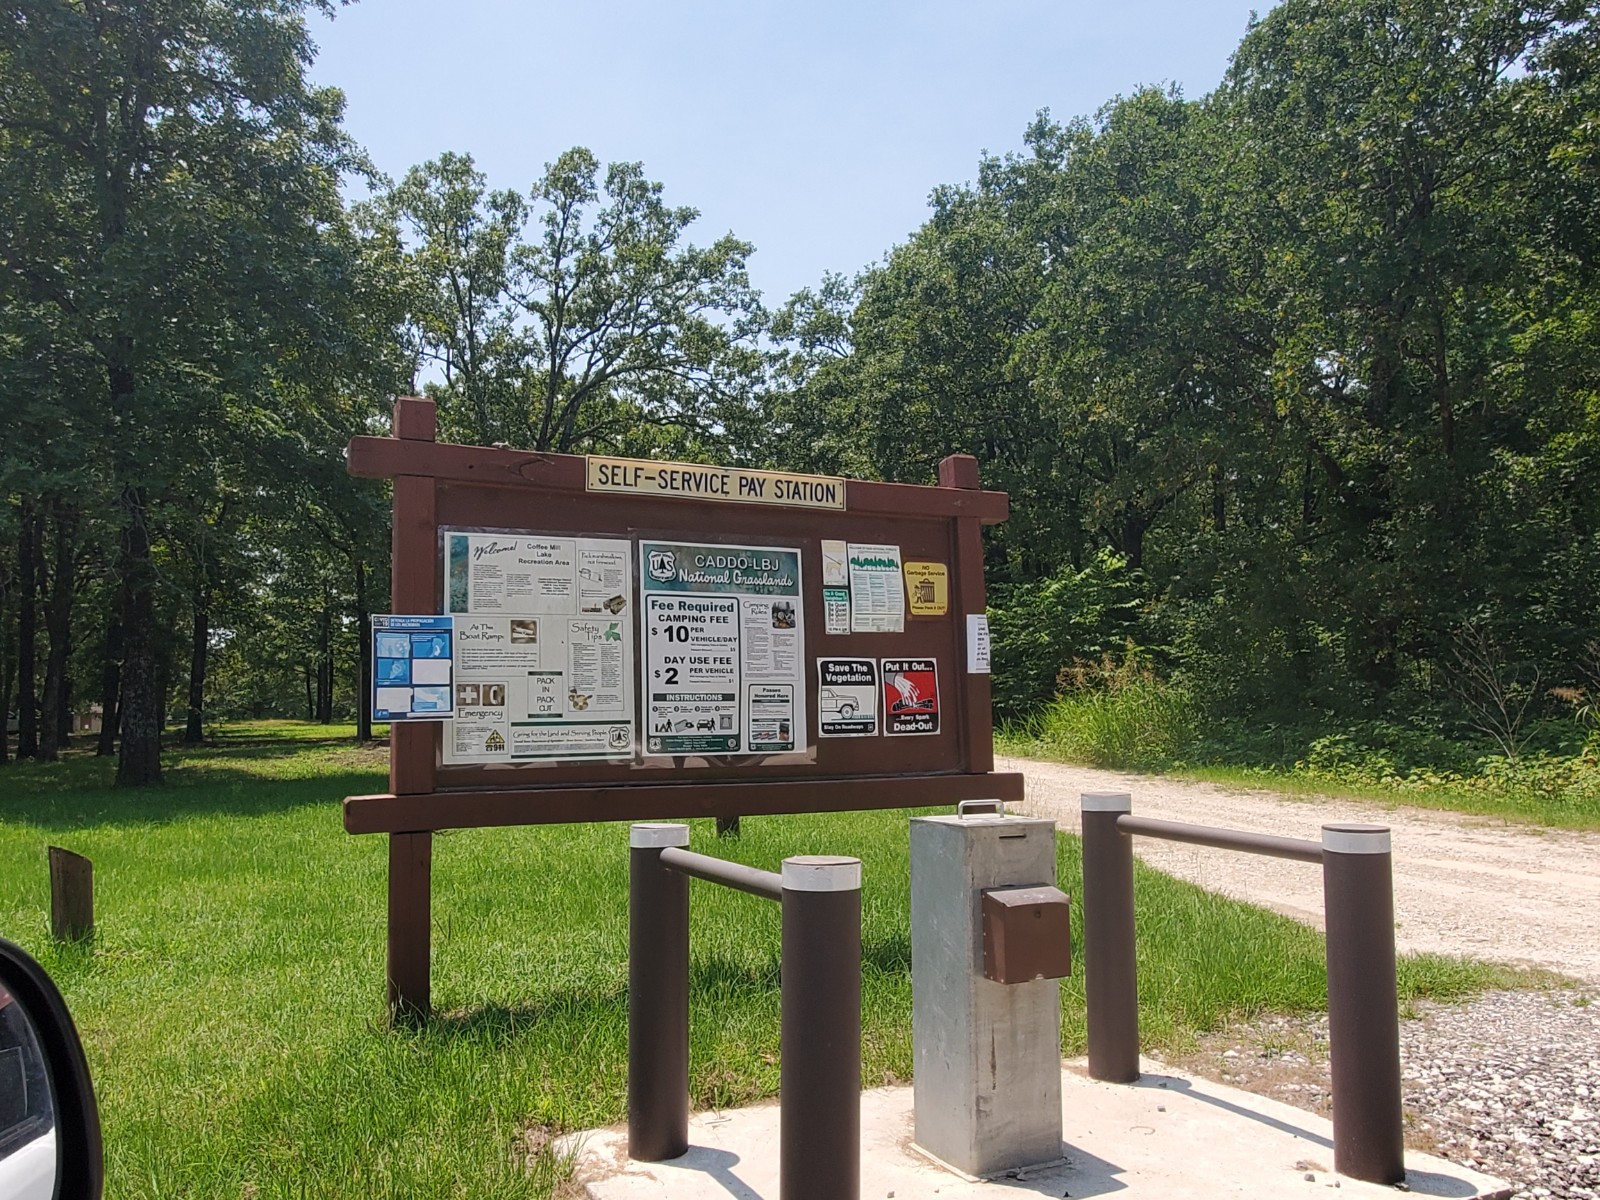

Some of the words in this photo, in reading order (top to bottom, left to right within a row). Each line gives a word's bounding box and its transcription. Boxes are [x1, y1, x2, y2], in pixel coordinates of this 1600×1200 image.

[598, 464, 730, 496] SELF-SERVICE
[739, 476, 767, 498] PAY
[774, 479, 836, 503] STATION
[527, 543, 548, 551] Coffee
[518, 558, 553, 566] Recreation
[694, 554, 780, 572] CADDO-LBJ
[678, 568, 731, 585] National
[733, 570, 794, 587] Grasslands
[651, 599, 674, 611] Fee
[678, 600, 735, 614] Required
[658, 613, 707, 623] CAMPING
[709, 615, 729, 624] FEE
[469, 623, 479, 631] At
[571, 622, 600, 635] Safety
[459, 630, 480, 641] Boat
[585, 631, 603, 643] Tips
[663, 624, 690, 643] 10
[664, 656, 687, 665] DAY
[689, 656, 710, 665] USE
[713, 656, 733, 665] FEE
[828, 664, 850, 672] Save
[851, 664, 868, 672] The
[885, 663, 900, 671] Put
[903, 663, 909, 671] It
[664, 667, 679, 685] 2
[825, 673, 872, 684] Vegetation
[666, 694, 723, 702] INSTRUCTIONS
[458, 707, 504, 720] Emergency
[893, 722, 933, 732] Dead-Out
[493, 744, 505, 752] 911
